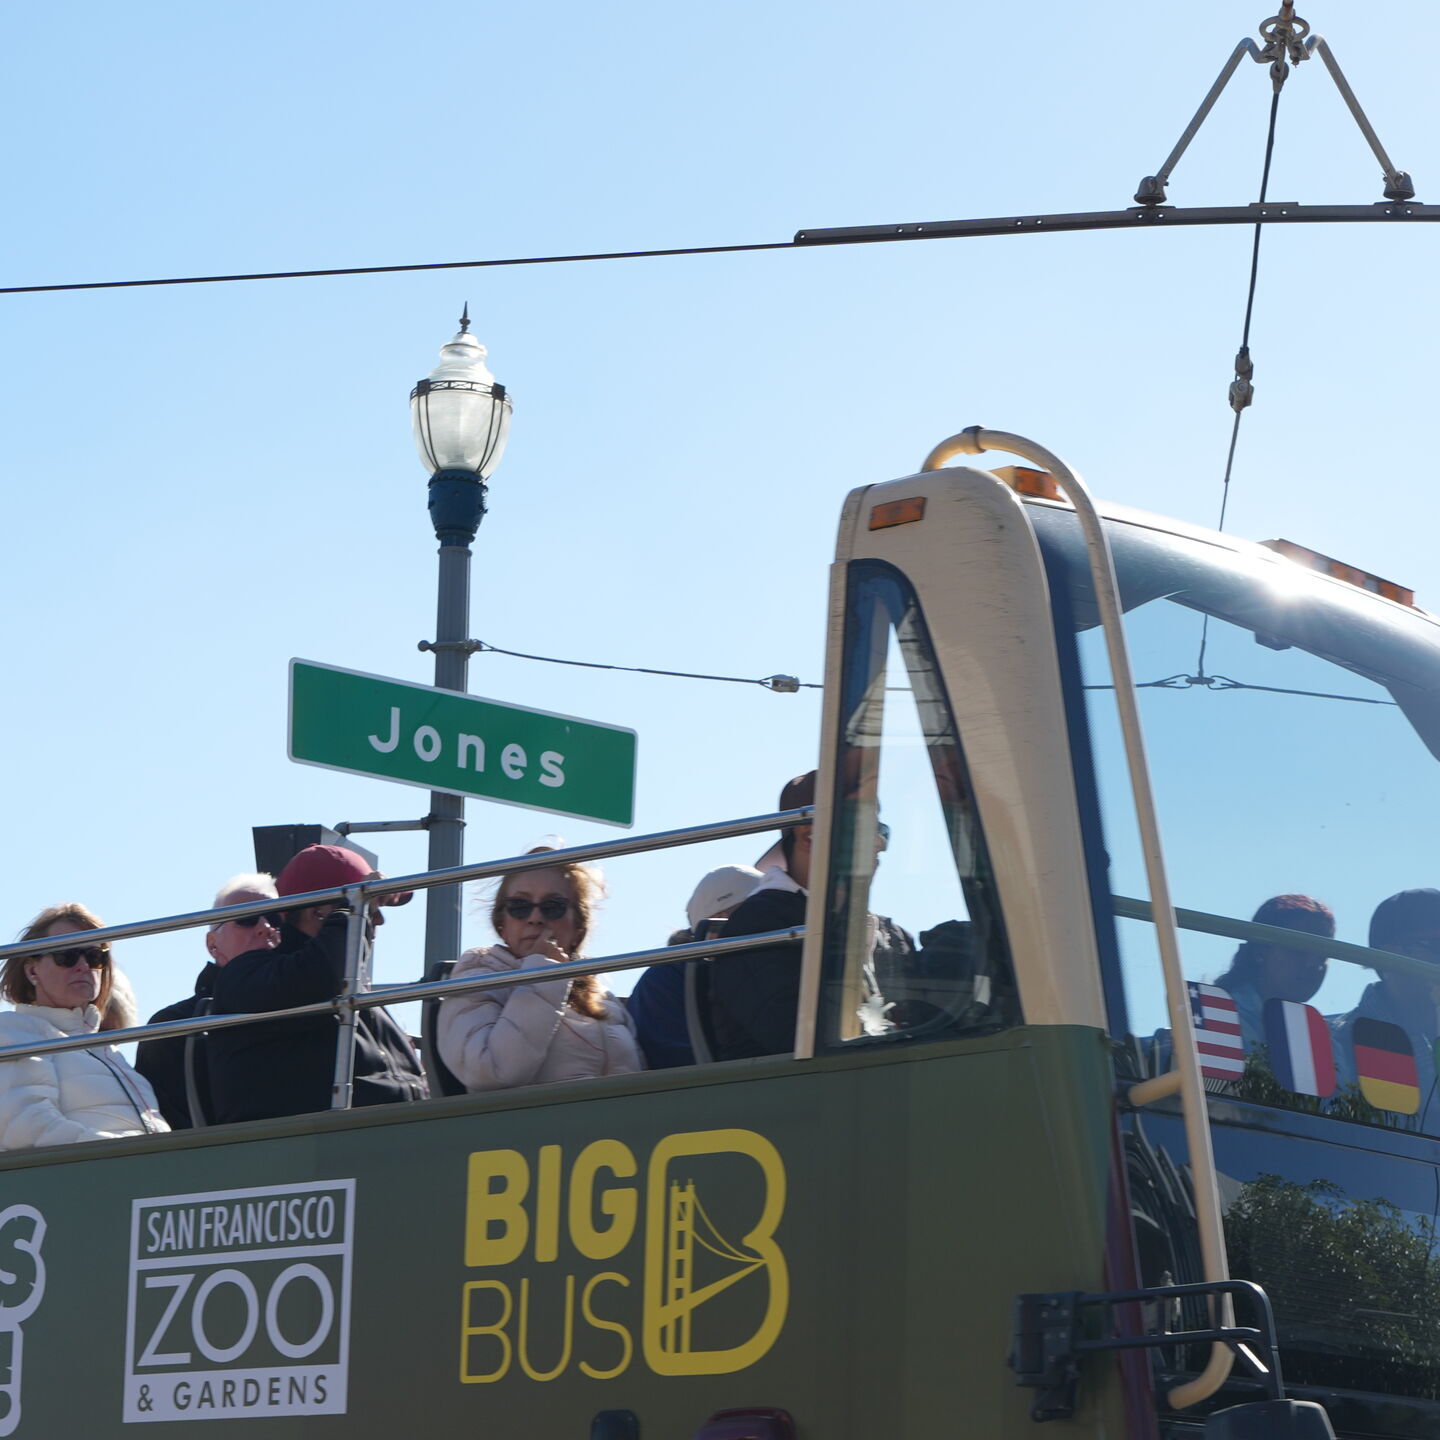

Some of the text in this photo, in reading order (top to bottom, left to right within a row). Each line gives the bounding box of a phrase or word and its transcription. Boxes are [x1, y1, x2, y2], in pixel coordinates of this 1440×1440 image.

[367, 706, 566, 788] Jones
[146, 1195, 335, 1253] SAN FRANCISCO
[464, 1138, 638, 1267] BIG
[136, 1262, 335, 1367] ZOO
[459, 1271, 634, 1384] BUS
[137, 1374, 328, 1412] & GARDENS
